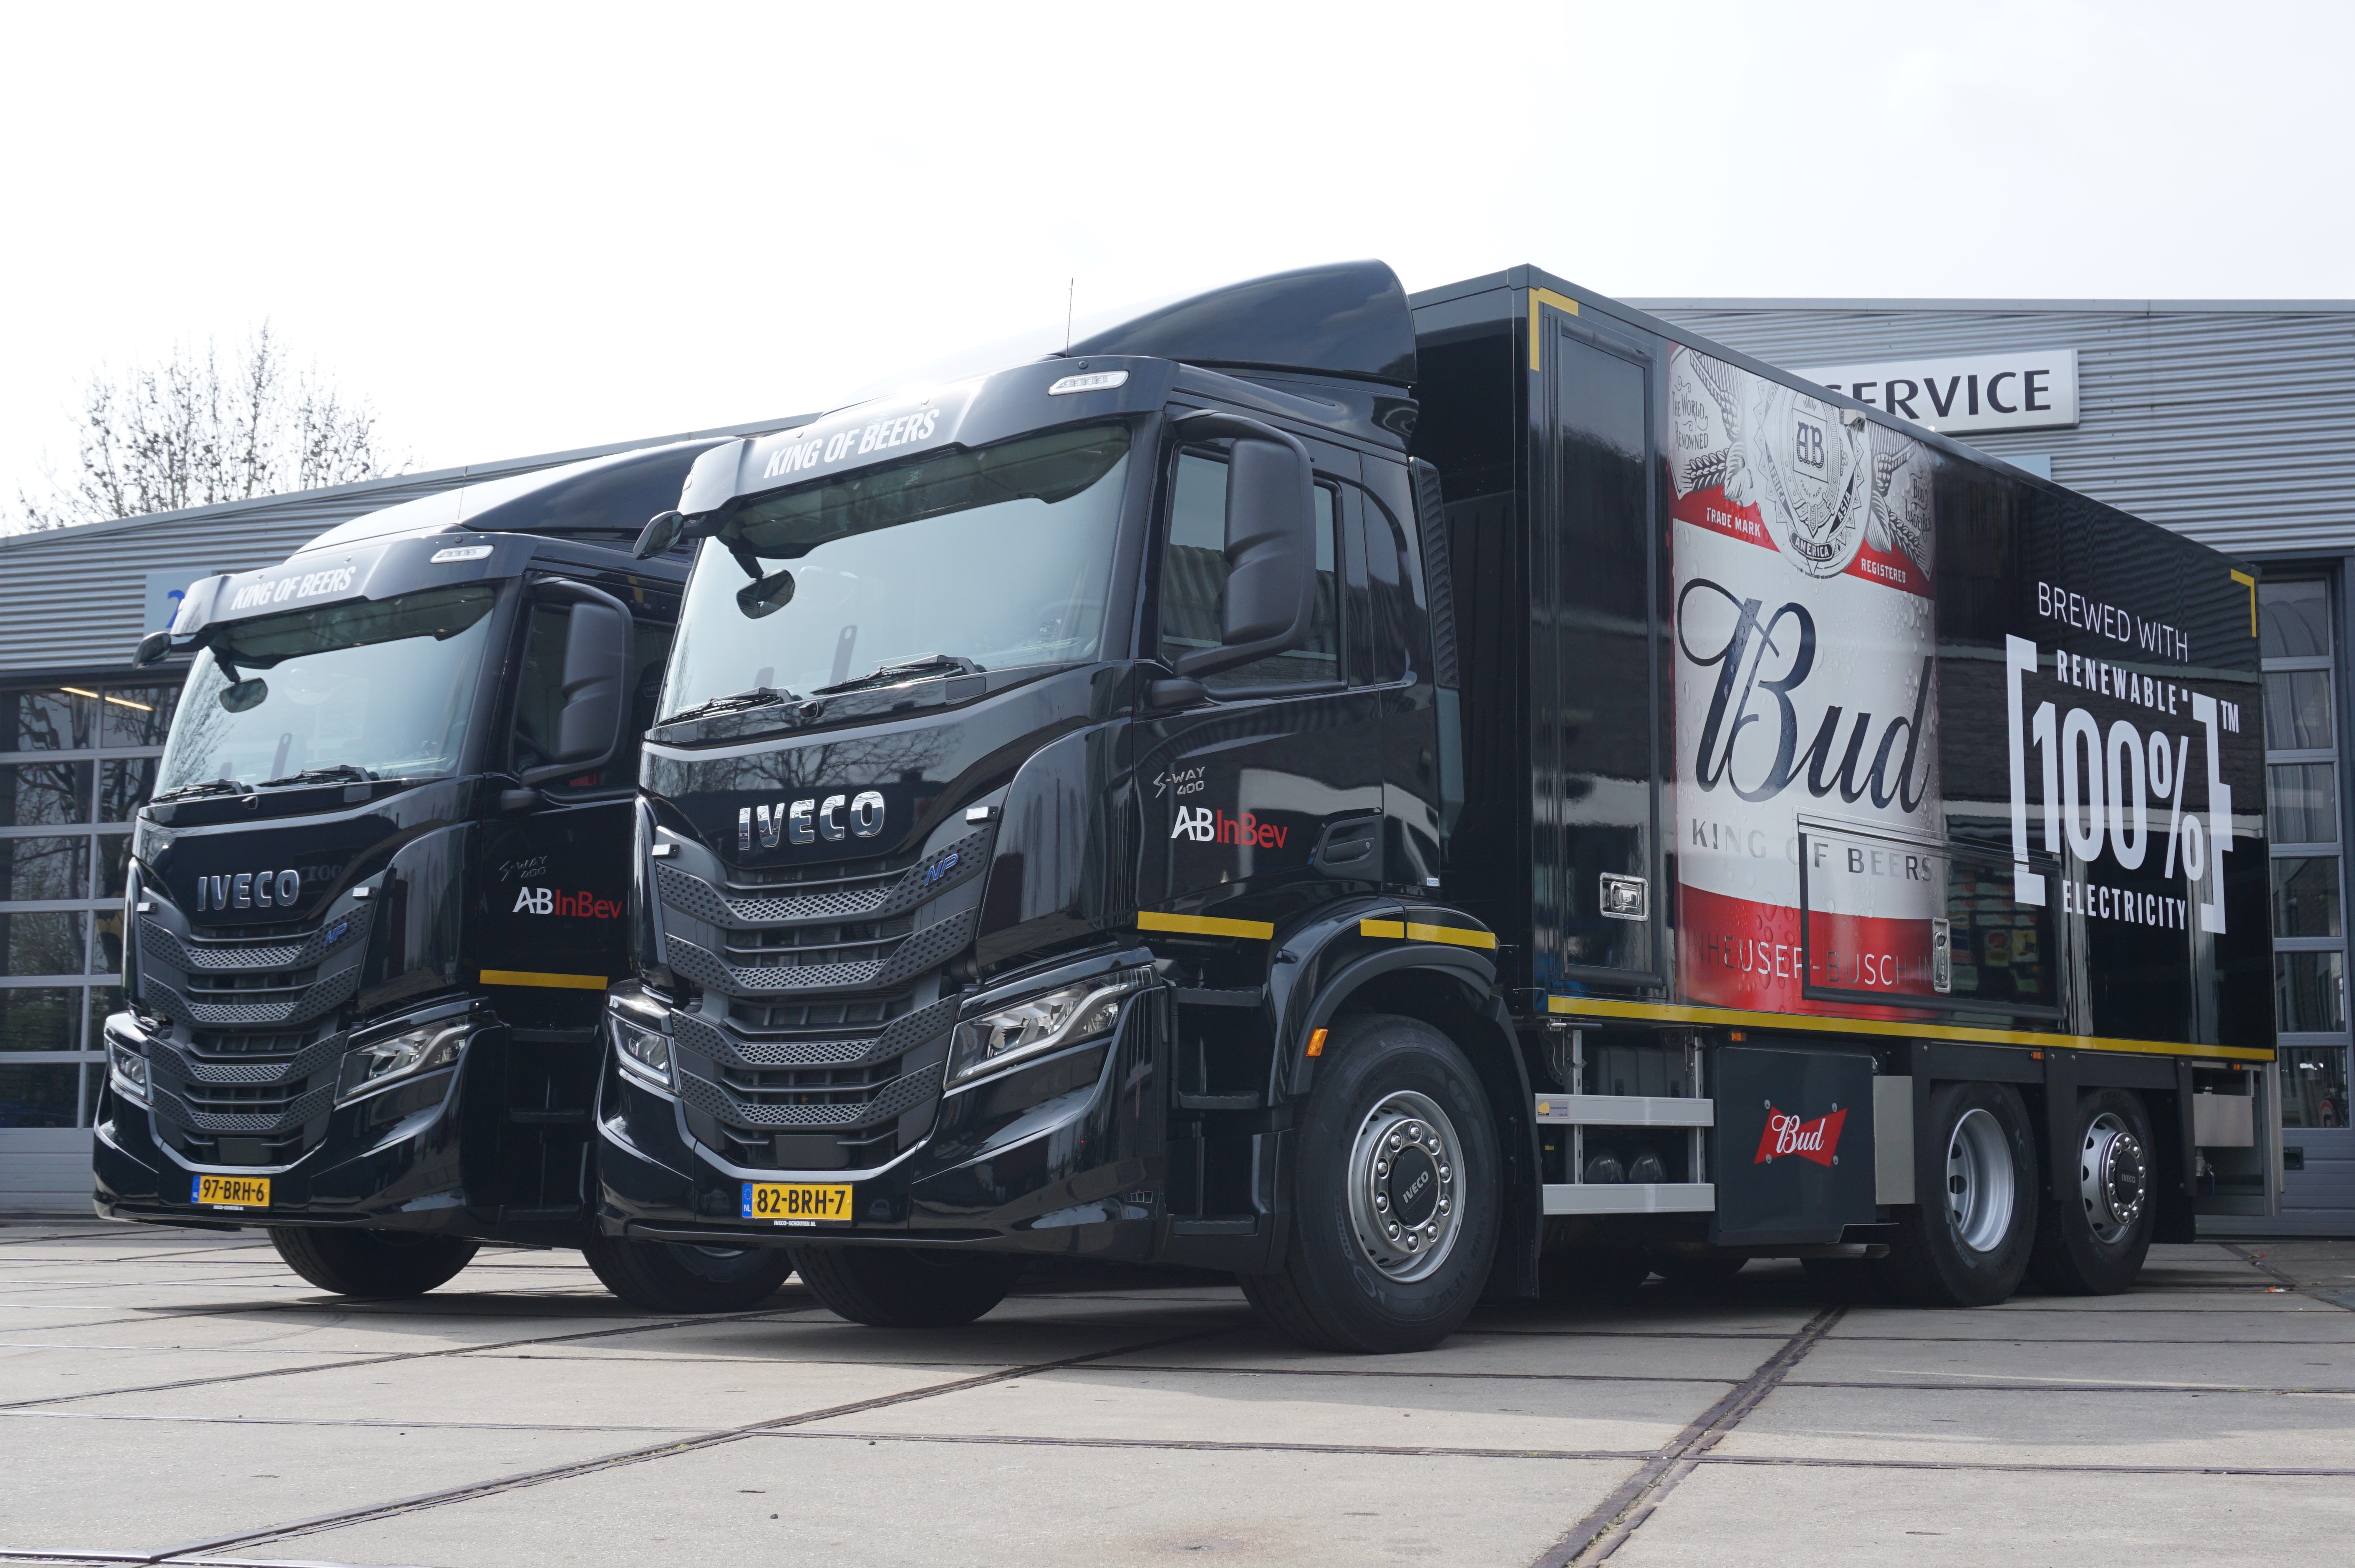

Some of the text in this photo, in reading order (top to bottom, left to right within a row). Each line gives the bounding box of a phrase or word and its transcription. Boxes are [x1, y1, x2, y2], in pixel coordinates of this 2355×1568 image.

[1672, 391, 1707, 424] THE WORLD
[1824, 369, 2051, 419] ERVICE
[764, 409, 939, 479] KING OF BEERS
[1675, 421, 1708, 451] RENOWNED
[1768, 463, 1786, 504] AFRICA
[1800, 478, 1822, 499] TRADE MARK
[1707, 507, 1760, 537] TRADE MARK
[1838, 491, 1852, 522] ASIA
[1795, 537, 1829, 557] AMERICA
[1861, 558, 1906, 584] REGISTERED
[230, 566, 356, 610] KING OF BEERS
[2039, 582, 2188, 663] BREWED WITH
[1677, 578, 1934, 813] Bud
[2057, 649, 2177, 715] RENEWABLE
[2221, 700, 2239, 733] TM
[1153, 766, 1205, 798] S-WAY
[1177, 780, 1204, 795] 400
[2033, 701, 2204, 881] 100%
[739, 791, 885, 851] IVECO
[1692, 818, 1766, 859] KING
[1848, 848, 1933, 882] BEERS
[924, 854, 958, 887] NP
[197, 869, 300, 911] IVECO
[2063, 880, 2186, 930] ELECTRICITY
[323, 923, 348, 947] NP
[1772, 1115, 1826, 1154] Bud
[203, 1179, 264, 1202] 97-BRH-6
[1403, 1171, 1429, 1203] IVECO
[2122, 1174, 2136, 1184] IVECO
[757, 1189, 846, 1215] 82-BRH-7
